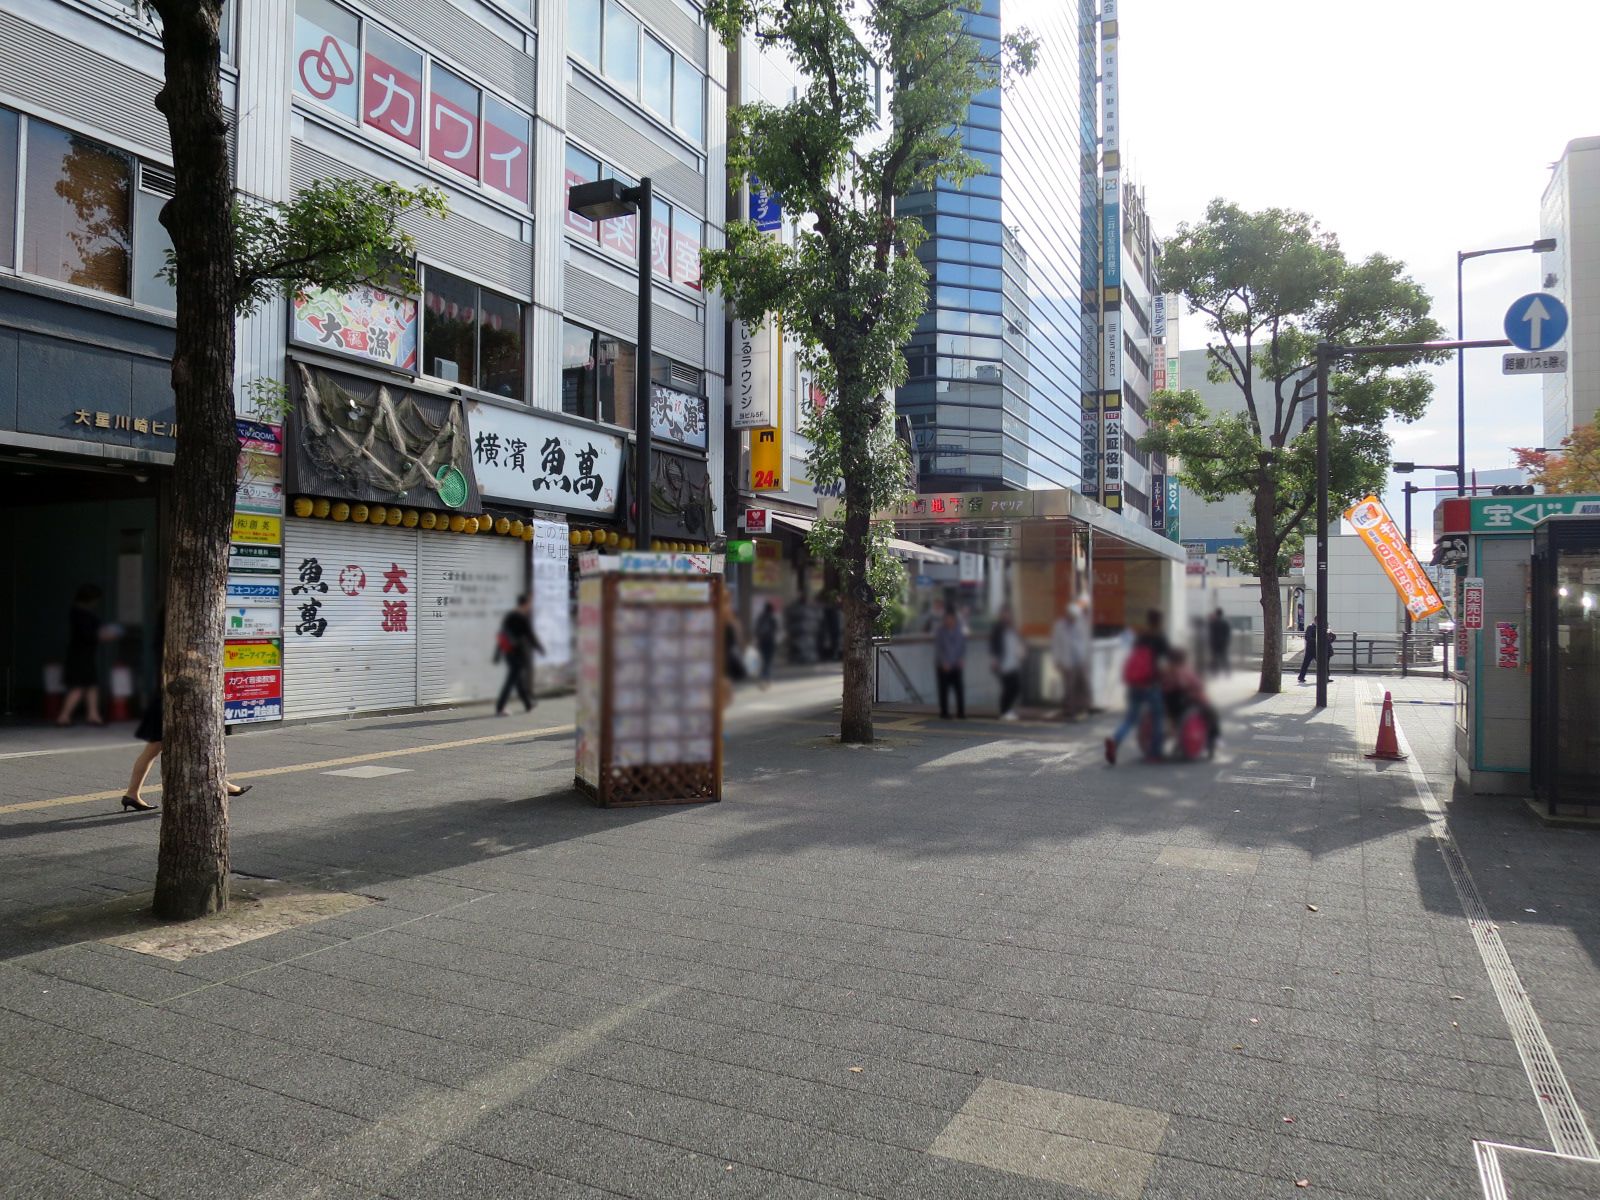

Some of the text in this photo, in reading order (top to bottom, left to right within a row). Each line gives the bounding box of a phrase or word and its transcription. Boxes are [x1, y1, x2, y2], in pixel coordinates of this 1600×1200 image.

[370, 73, 522, 189] カワイ
[1505, 356, 1566, 370] 路線バスを除く
[474, 431, 604, 502] 横濱 魚萬
[1168, 482, 1177, 511] NOVA
[1483, 504, 1562, 526] 宝くじ
[291, 557, 328, 637] 魚萬
[381, 562, 409, 632] 大漁
[1466, 590, 1481, 626] 発売中
